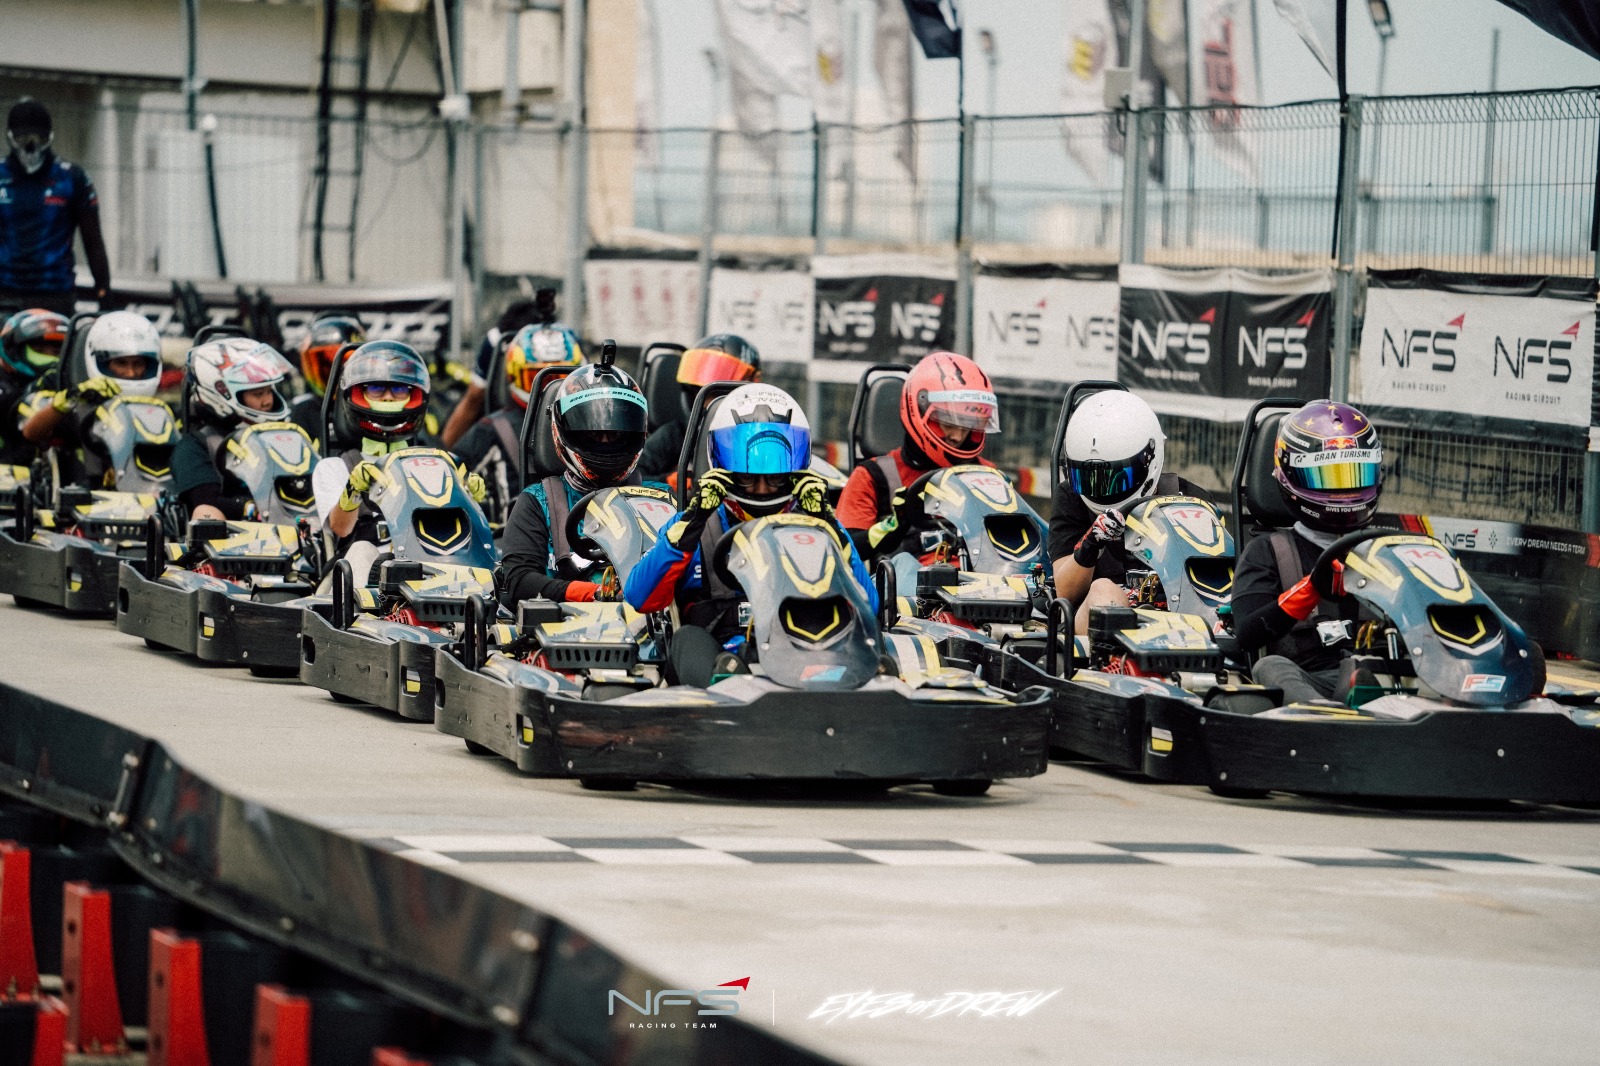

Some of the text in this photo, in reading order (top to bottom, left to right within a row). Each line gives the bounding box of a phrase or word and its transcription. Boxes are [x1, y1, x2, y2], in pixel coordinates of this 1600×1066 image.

[819, 301, 876, 338] NFS
[890, 302, 941, 342] NFS
[987, 311, 1042, 346] NFS
[1131, 318, 1211, 364] NFS
[1238, 325, 1308, 369] NFS
[1381, 327, 1457, 373] NFS
[1493, 335, 1572, 384] NFS
[1392, 381, 1446, 392] RACING CIRCUIT
[1505, 391, 1561, 405] RACING CIRCUIT
[410, 458, 438, 467] 13
[1314, 451, 1336, 462] GRAN
[1339, 450, 1371, 460] TURISMO
[970, 478, 1002, 486] 15
[637, 502, 670, 514] 11
[1172, 509, 1204, 519] 17
[793, 533, 816, 545] 9
[1444, 532, 1476, 548] NFS
[1527, 538, 1550, 550] DREAM
[1550, 541, 1568, 552] NEEDS
[1572, 544, 1586, 555] TEAM
[1405, 549, 1443, 560] 14
